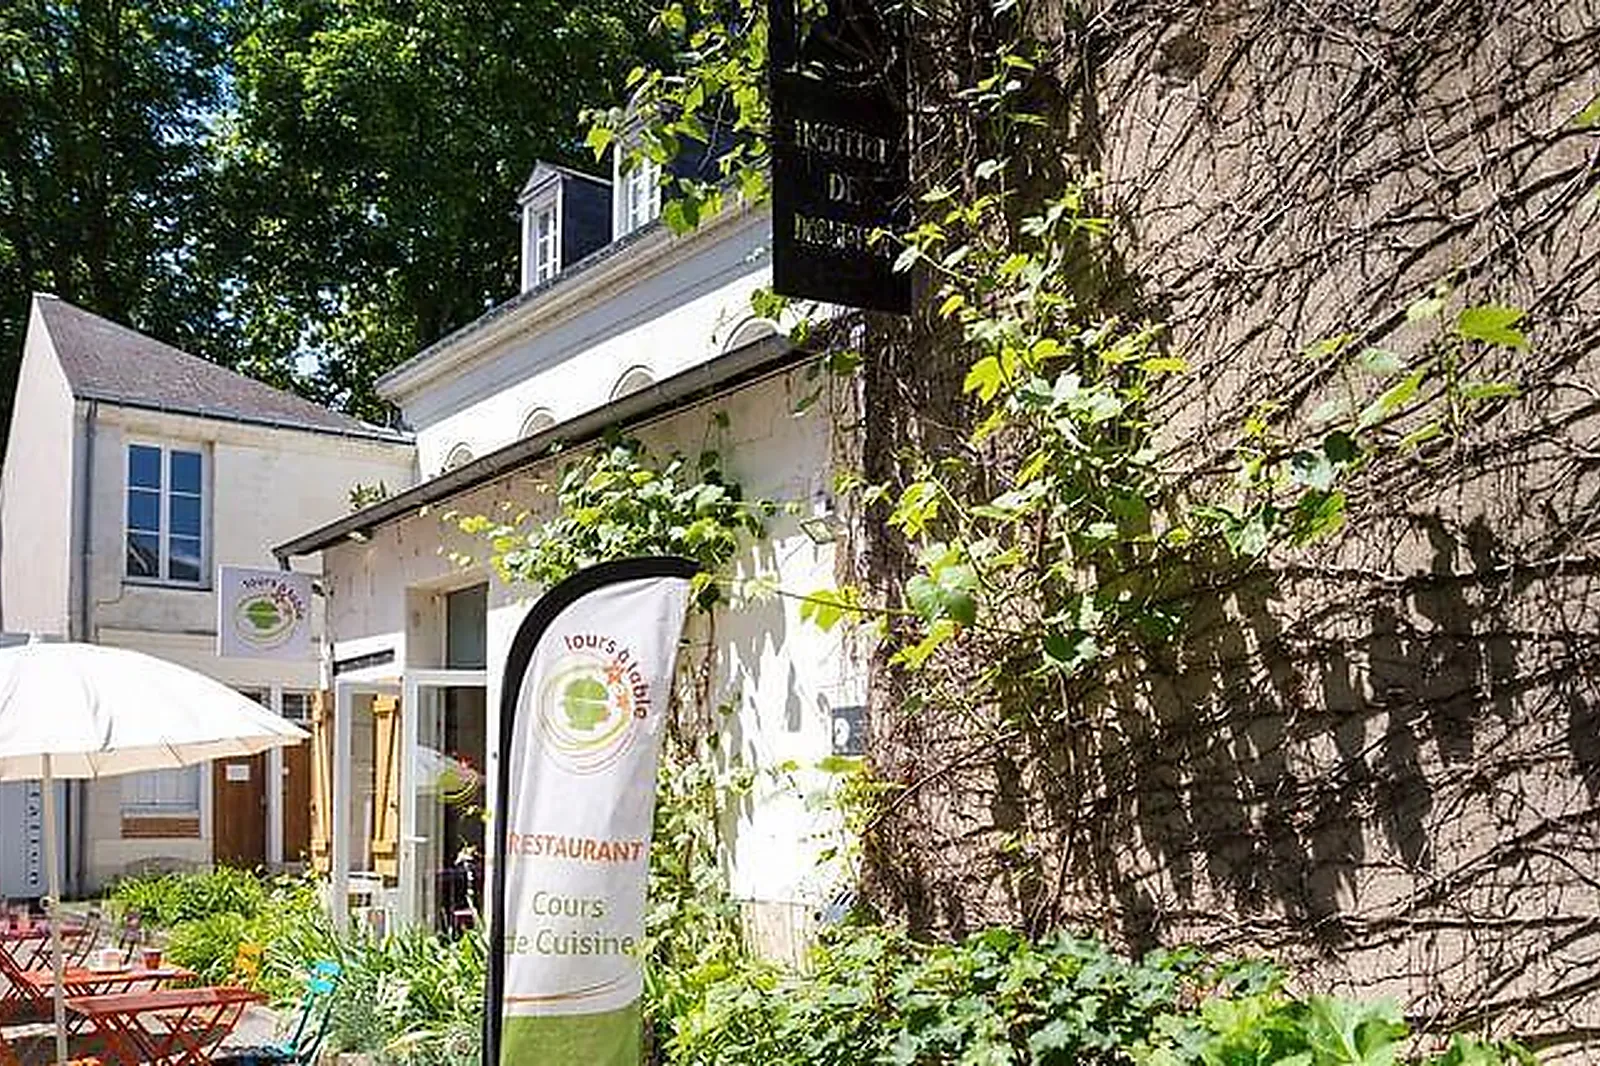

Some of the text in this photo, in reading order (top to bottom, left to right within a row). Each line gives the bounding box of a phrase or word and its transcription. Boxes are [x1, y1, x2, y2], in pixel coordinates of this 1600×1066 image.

[564, 634, 617, 655] tours
[626, 662, 652, 720] table
[507, 832, 644, 862] RESTAURANT
[532, 891, 605, 918] Cours
[536, 929, 636, 955] Cuisine
